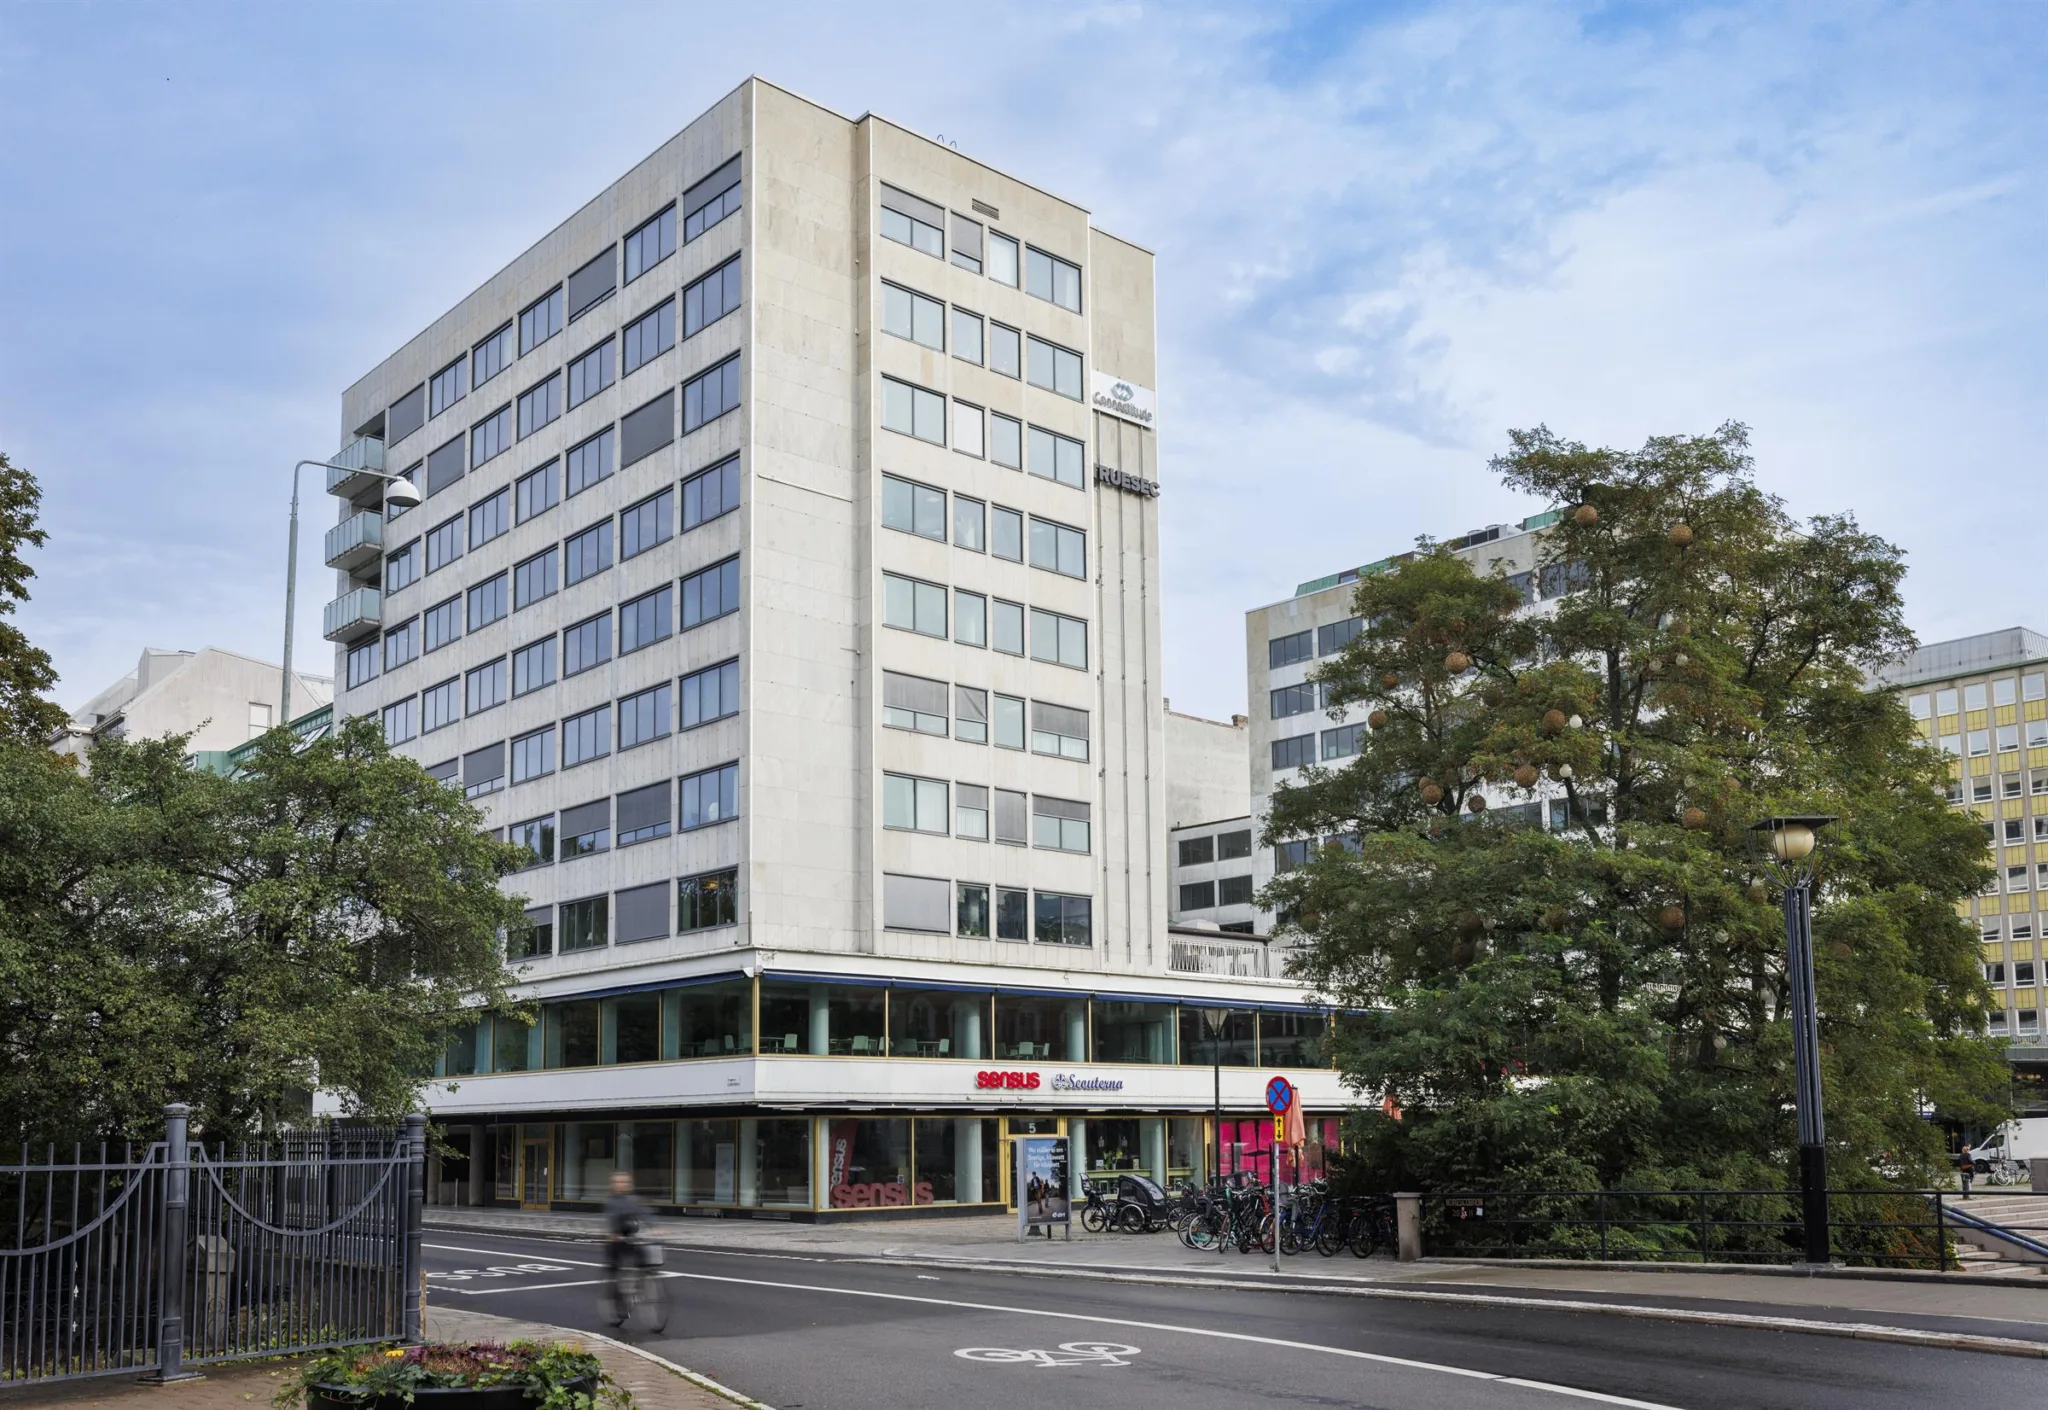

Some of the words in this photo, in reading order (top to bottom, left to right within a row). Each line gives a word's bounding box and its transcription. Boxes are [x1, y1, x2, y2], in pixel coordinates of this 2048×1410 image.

[1093, 463, 1161, 499] TRUESEC
[976, 1070, 1041, 1089] sensus
[1067, 1073, 1125, 1091] Scouterna
[1028, 1122, 1037, 1134] 5
[830, 1138, 847, 1187] ensus
[426, 1263, 575, 1281] BUSS
